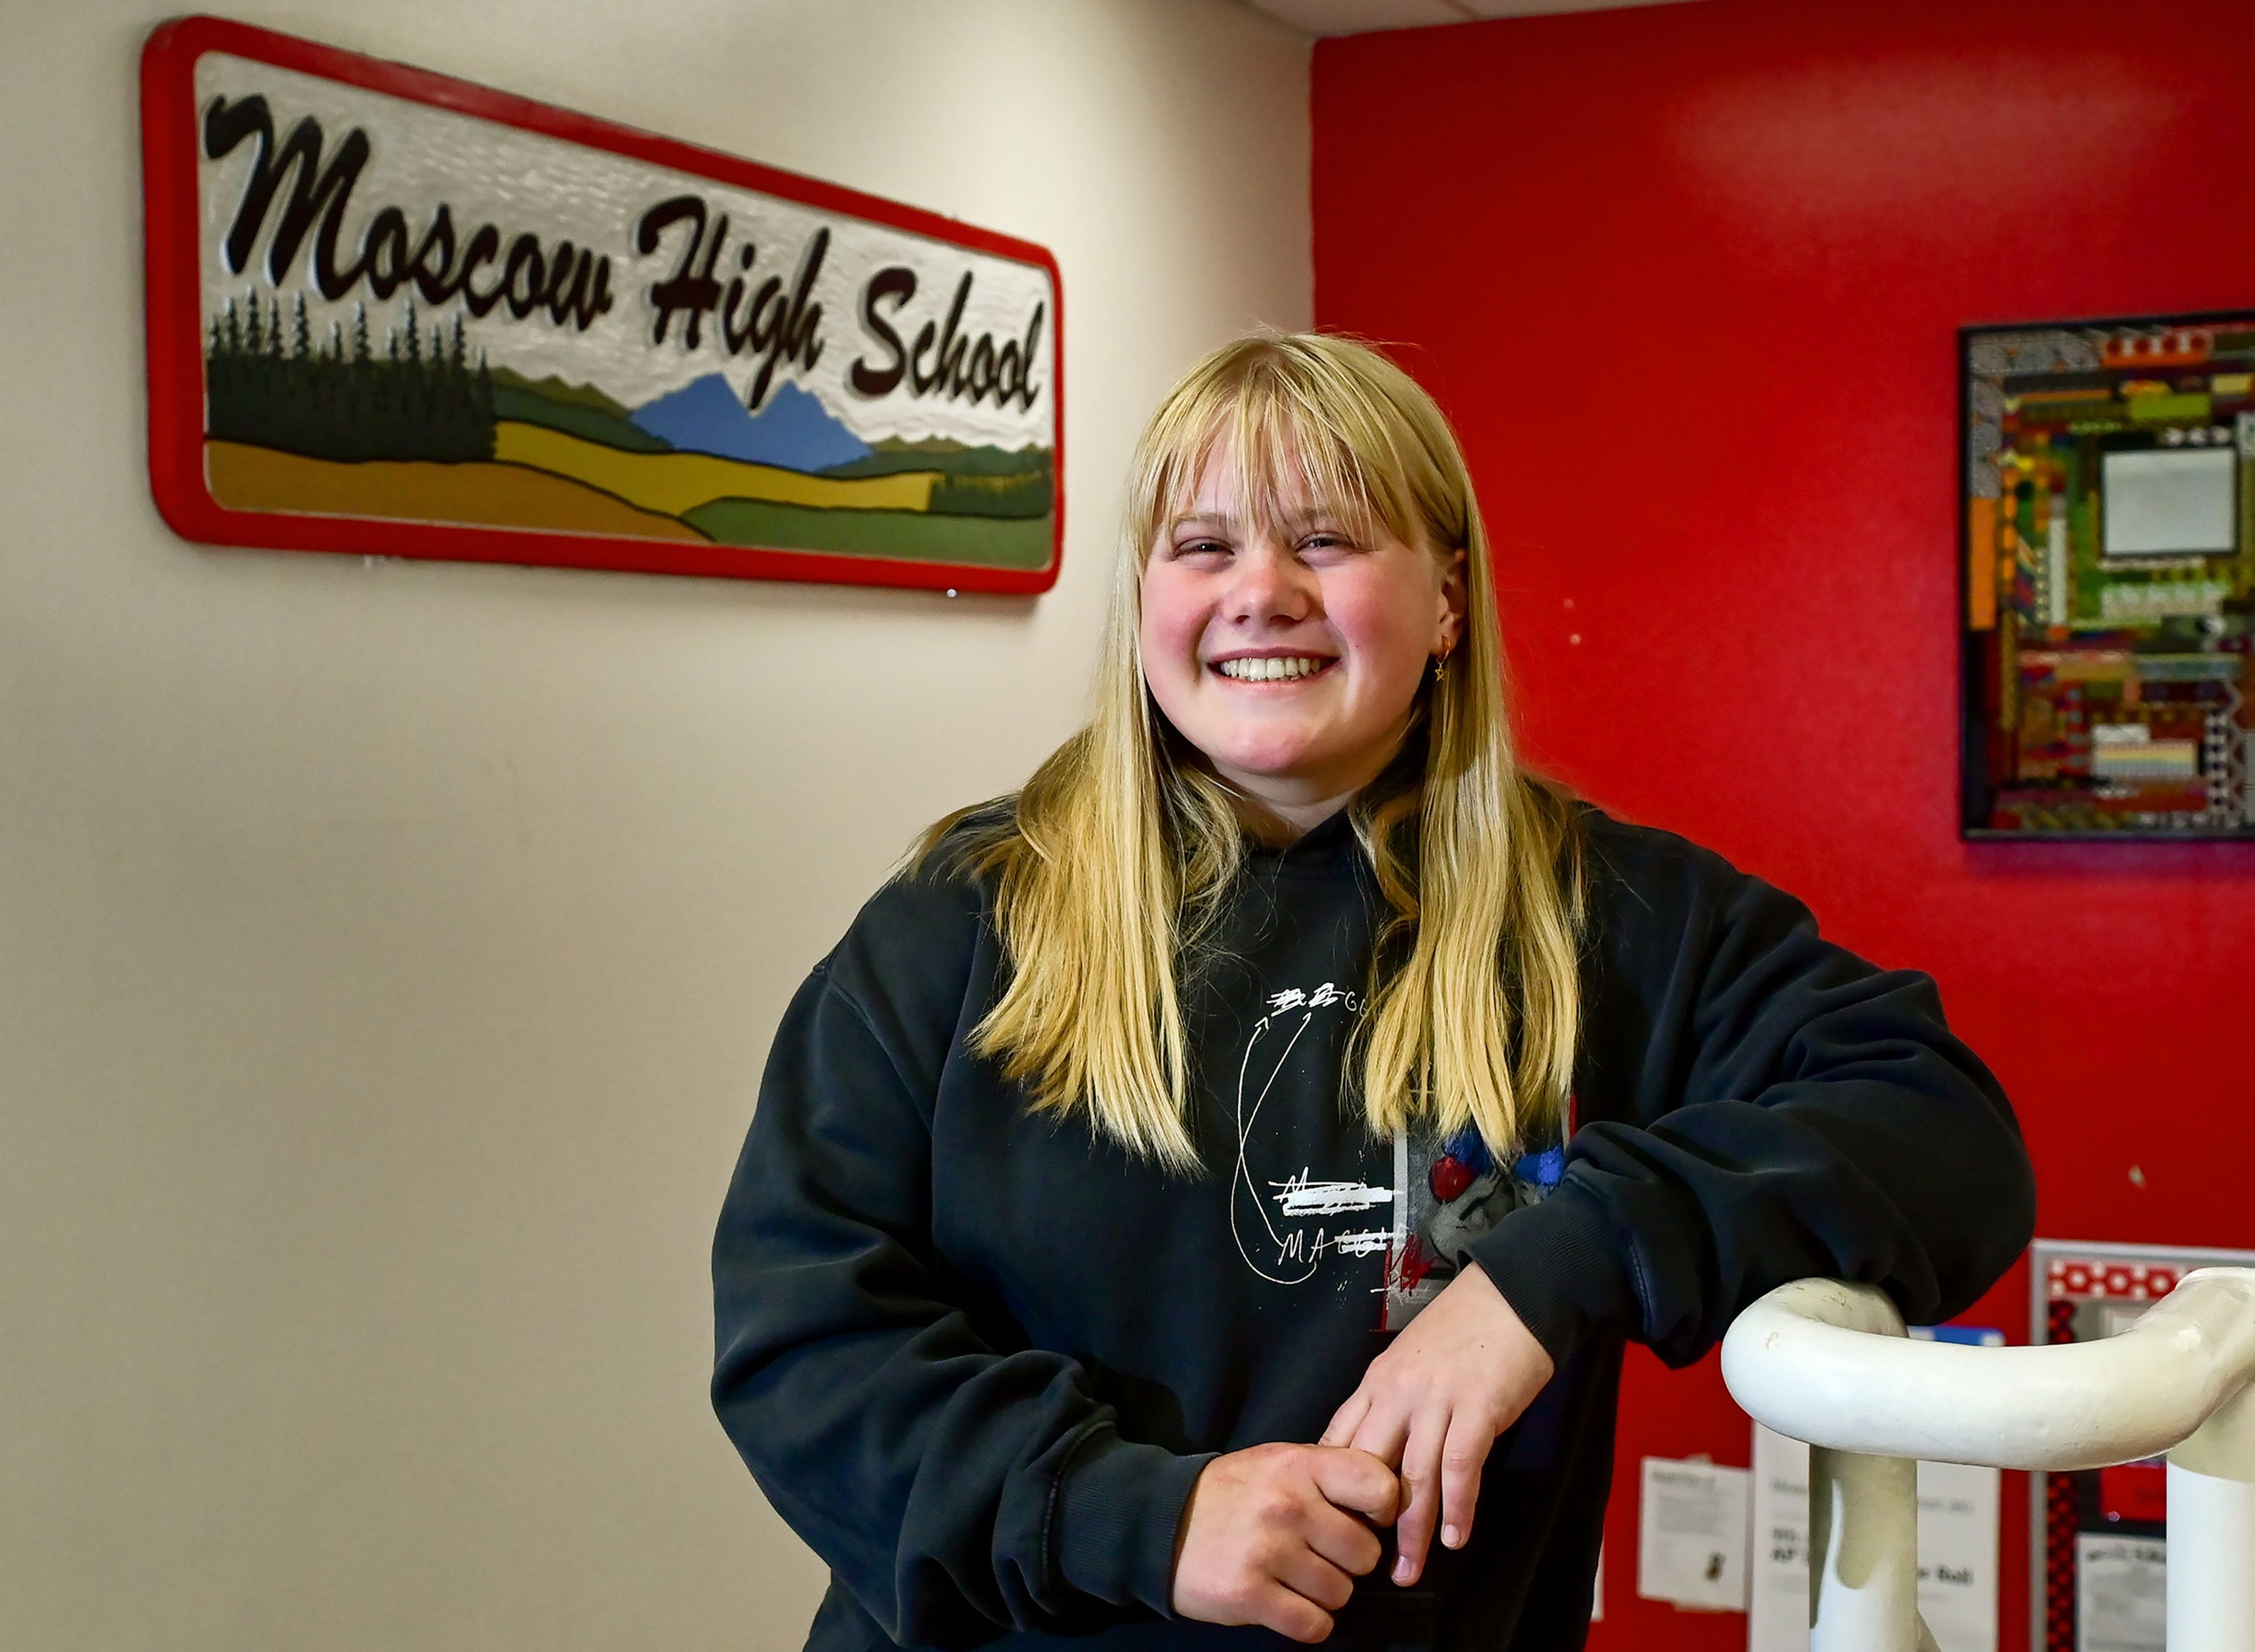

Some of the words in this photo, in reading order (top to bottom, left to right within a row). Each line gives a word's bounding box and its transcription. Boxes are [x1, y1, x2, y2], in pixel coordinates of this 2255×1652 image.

[206, 93, 614, 332] Moscow
[638, 195, 830, 409] High
[851, 267, 1044, 408] School
